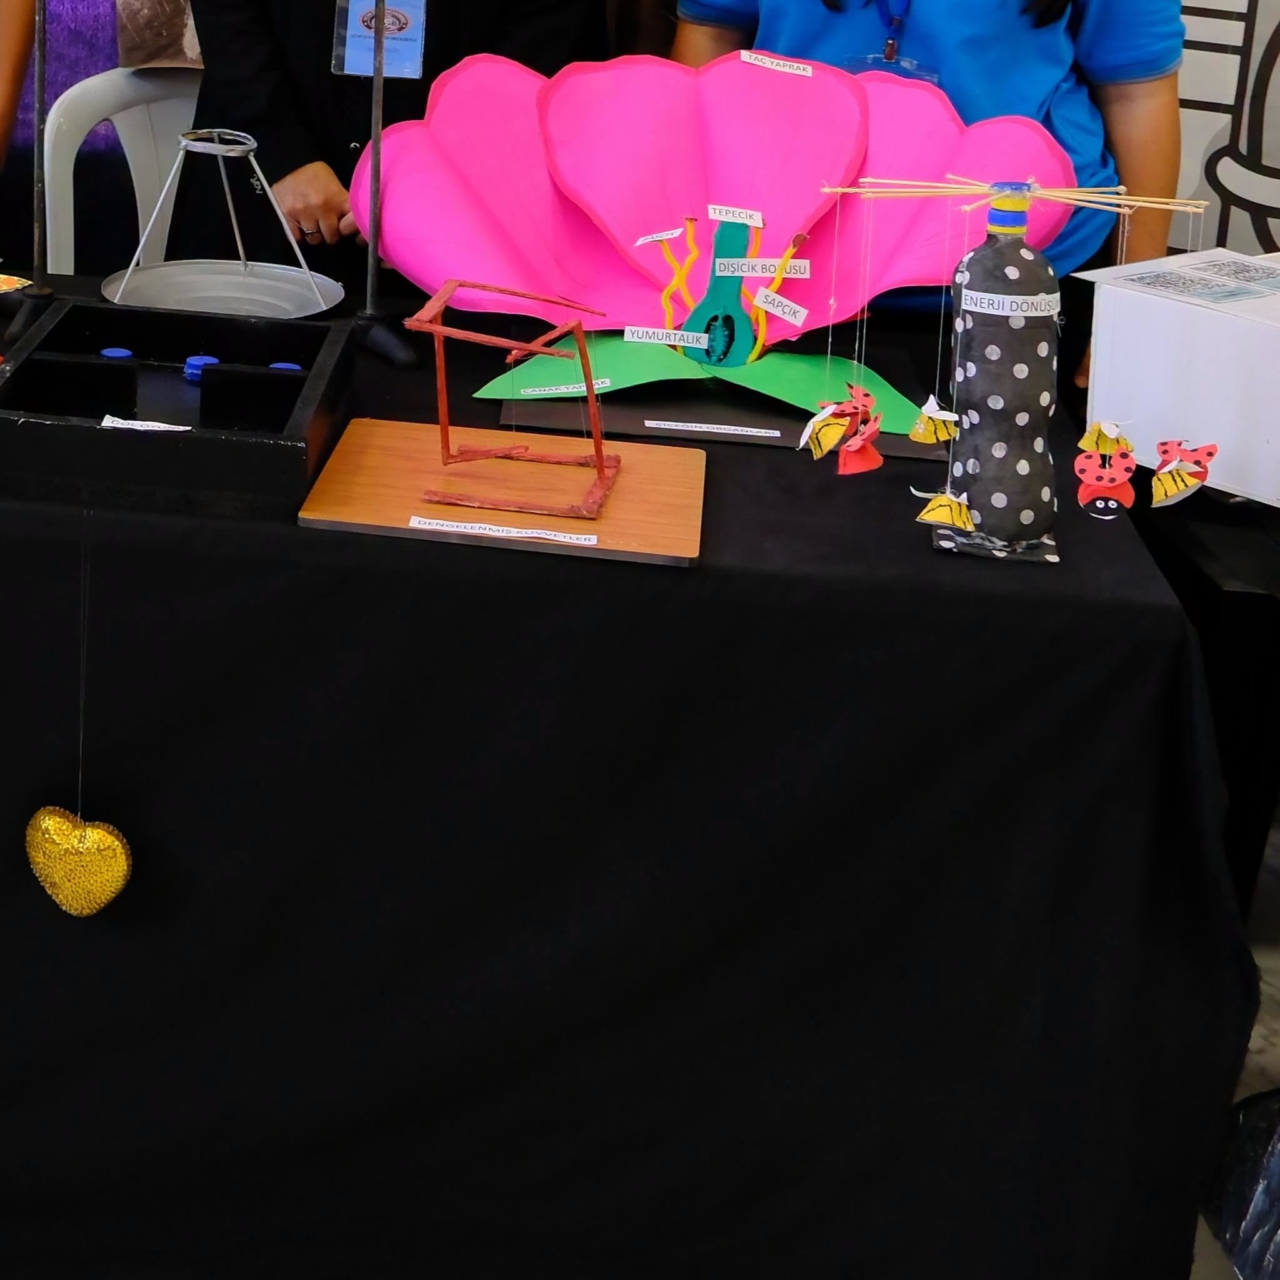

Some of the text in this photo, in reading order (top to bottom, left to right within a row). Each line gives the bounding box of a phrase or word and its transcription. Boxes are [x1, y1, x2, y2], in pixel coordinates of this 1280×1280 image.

[712, 207, 756, 221] TEPECİK
[718, 261, 807, 276] DİŞİCİK BOUSU
[762, 293, 801, 320] SAPÇIK
[964, 294, 1005, 311] ENERJİ
[630, 328, 703, 345] YUMURTALIK
[564, 380, 609, 391] YAPAK
